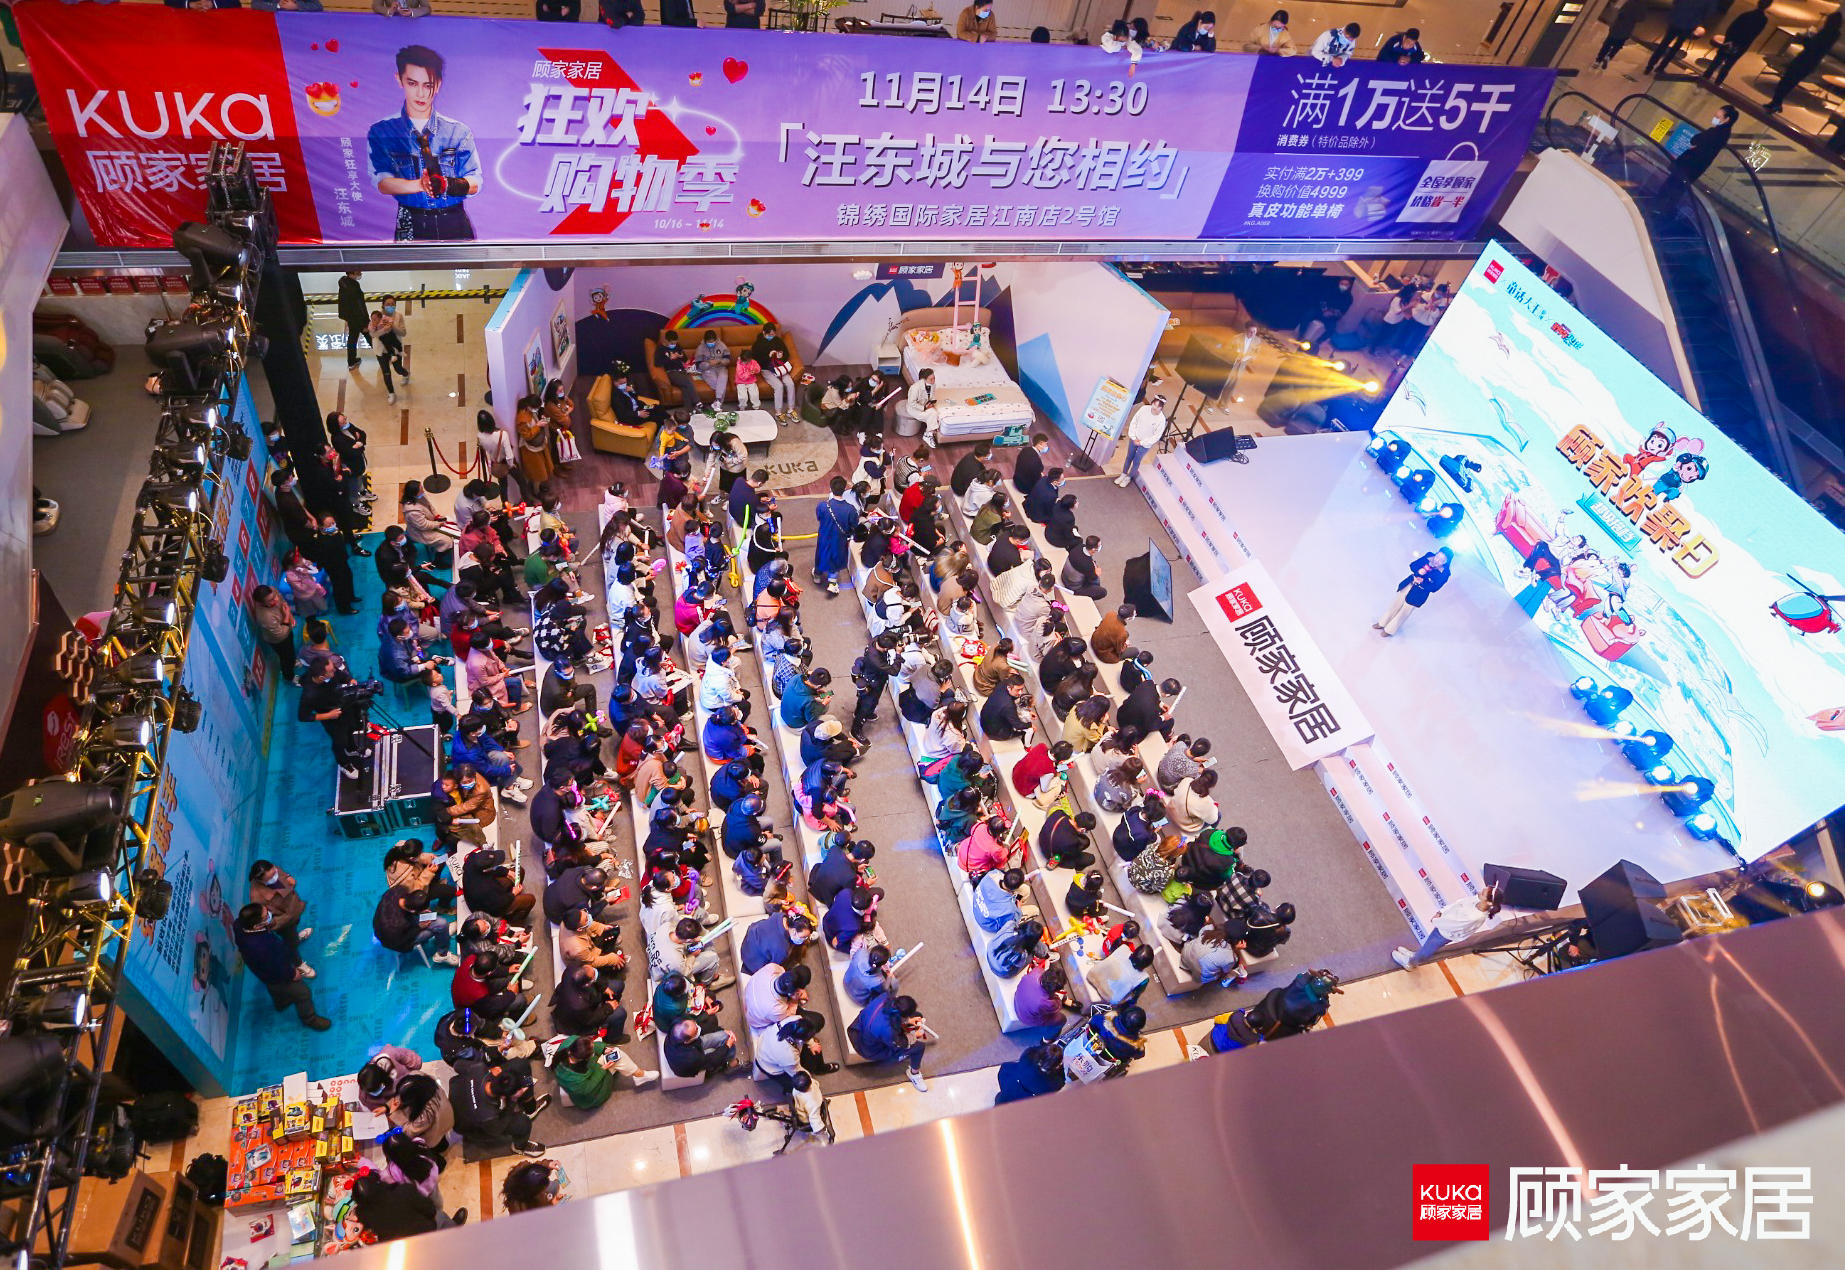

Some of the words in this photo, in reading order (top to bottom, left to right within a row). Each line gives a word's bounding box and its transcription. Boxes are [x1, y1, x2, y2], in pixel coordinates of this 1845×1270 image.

[532, 60, 602, 79] 顾家家居
[859, 71, 1027, 116] 11月14日
[1047, 79, 1149, 116] 13:30
[1282, 72, 1515, 134] 满1万送5千
[518, 83, 652, 147] 狂欢
[539, 153, 740, 214] 购物季
[1256, 184, 1348, 198] 换购价值4999
[1264, 166, 1364, 181] 实付满2万+399
[334, 188, 355, 228] 汪东城
[836, 203, 1121, 228] 锦绣国际家居江南店2号馆
[1248, 202, 1345, 219] 真皮功能单椅
[1235, 615, 1341, 744] 顾家家居
